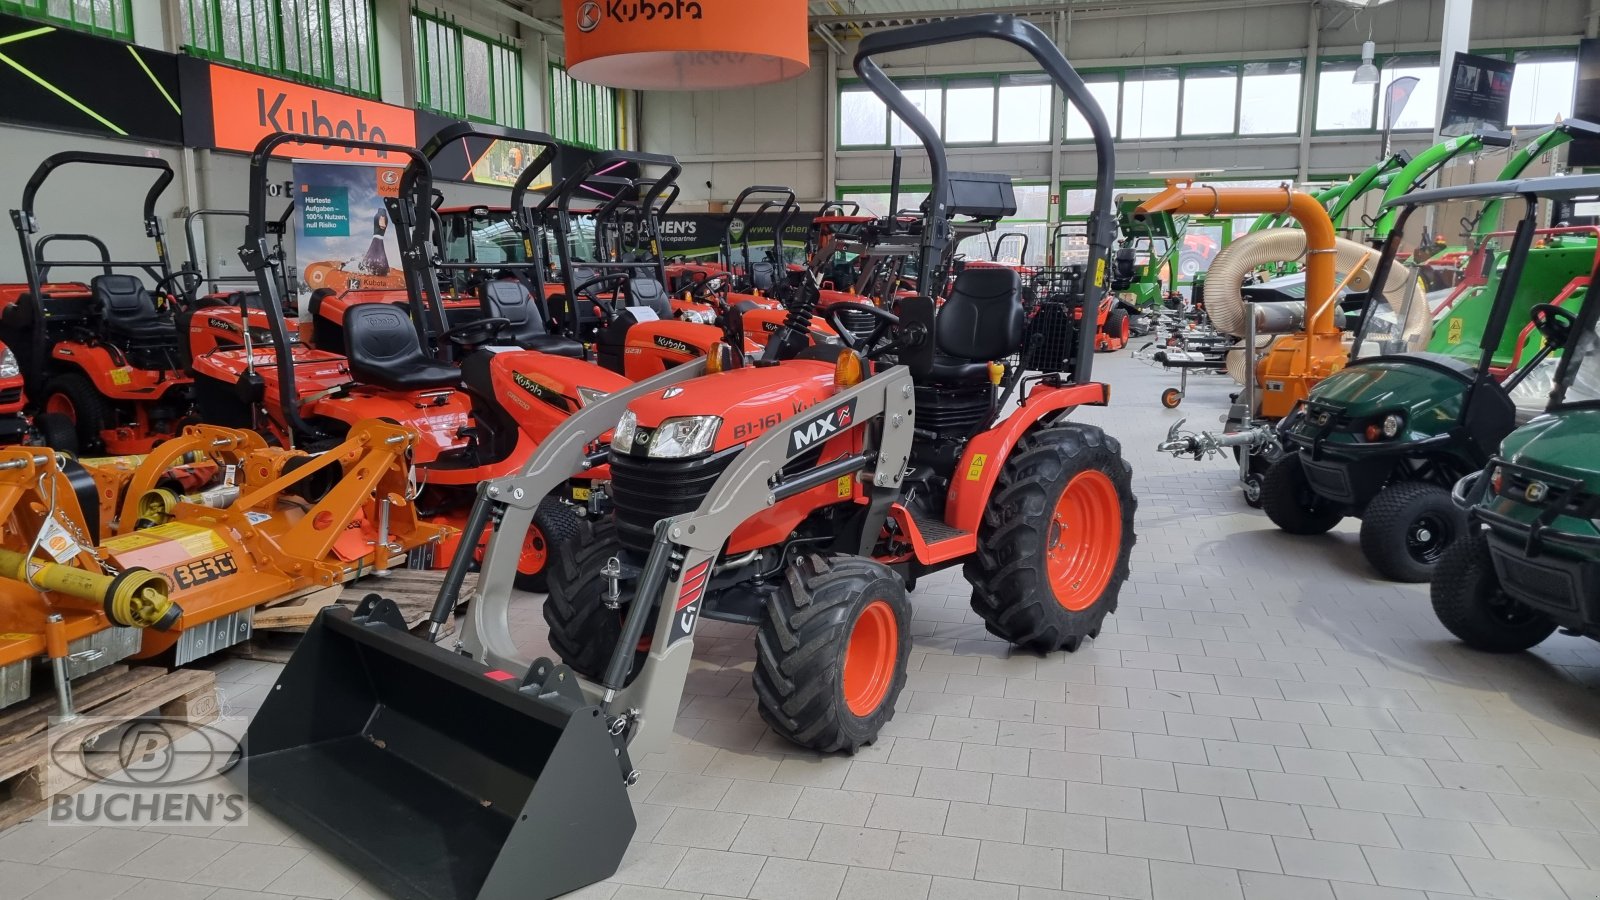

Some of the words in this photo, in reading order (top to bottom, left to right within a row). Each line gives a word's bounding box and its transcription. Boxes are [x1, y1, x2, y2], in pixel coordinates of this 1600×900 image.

[606, 0, 703, 23] Kubota
[257, 88, 388, 159] Kubota
[304, 196, 332, 204] Härteste
[305, 205, 335, 213] Aufgaben
[306, 213, 324, 221] 100%
[324, 213, 348, 221] Nutzen,
[306, 221, 318, 229] null
[363, 279, 387, 287] Kubota
[658, 336, 686, 351] Kubota
[515, 373, 542, 396] Kubota
[733, 412, 782, 440] B1-161
[793, 412, 837, 450] MX
[680, 605, 697, 634] C1
